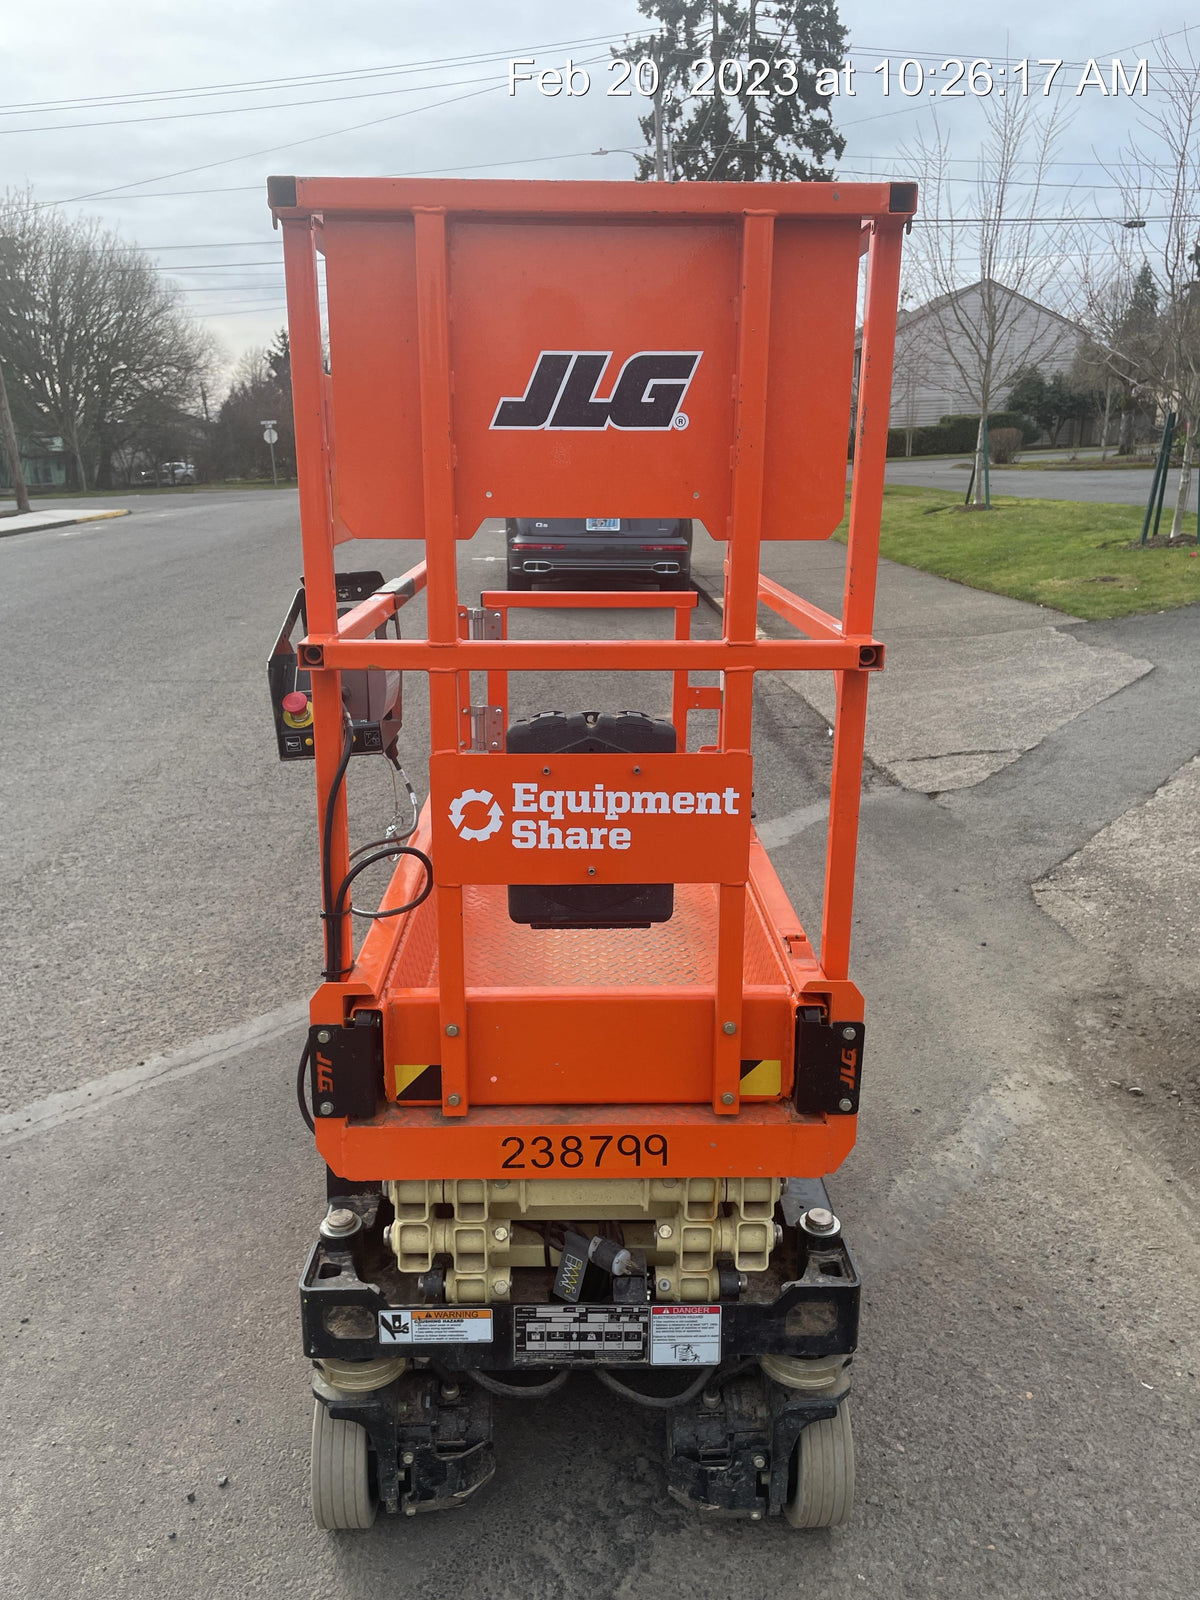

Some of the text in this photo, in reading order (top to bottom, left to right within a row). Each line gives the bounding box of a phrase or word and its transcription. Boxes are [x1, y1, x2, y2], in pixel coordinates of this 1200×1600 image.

[488, 350, 704, 431] JLG
[512, 783, 740, 820] Equipment
[512, 820, 632, 850] Share
[316, 1051, 334, 1093] JLG
[839, 1047, 858, 1090] JLG
[501, 1134, 668, 1169] 238799
